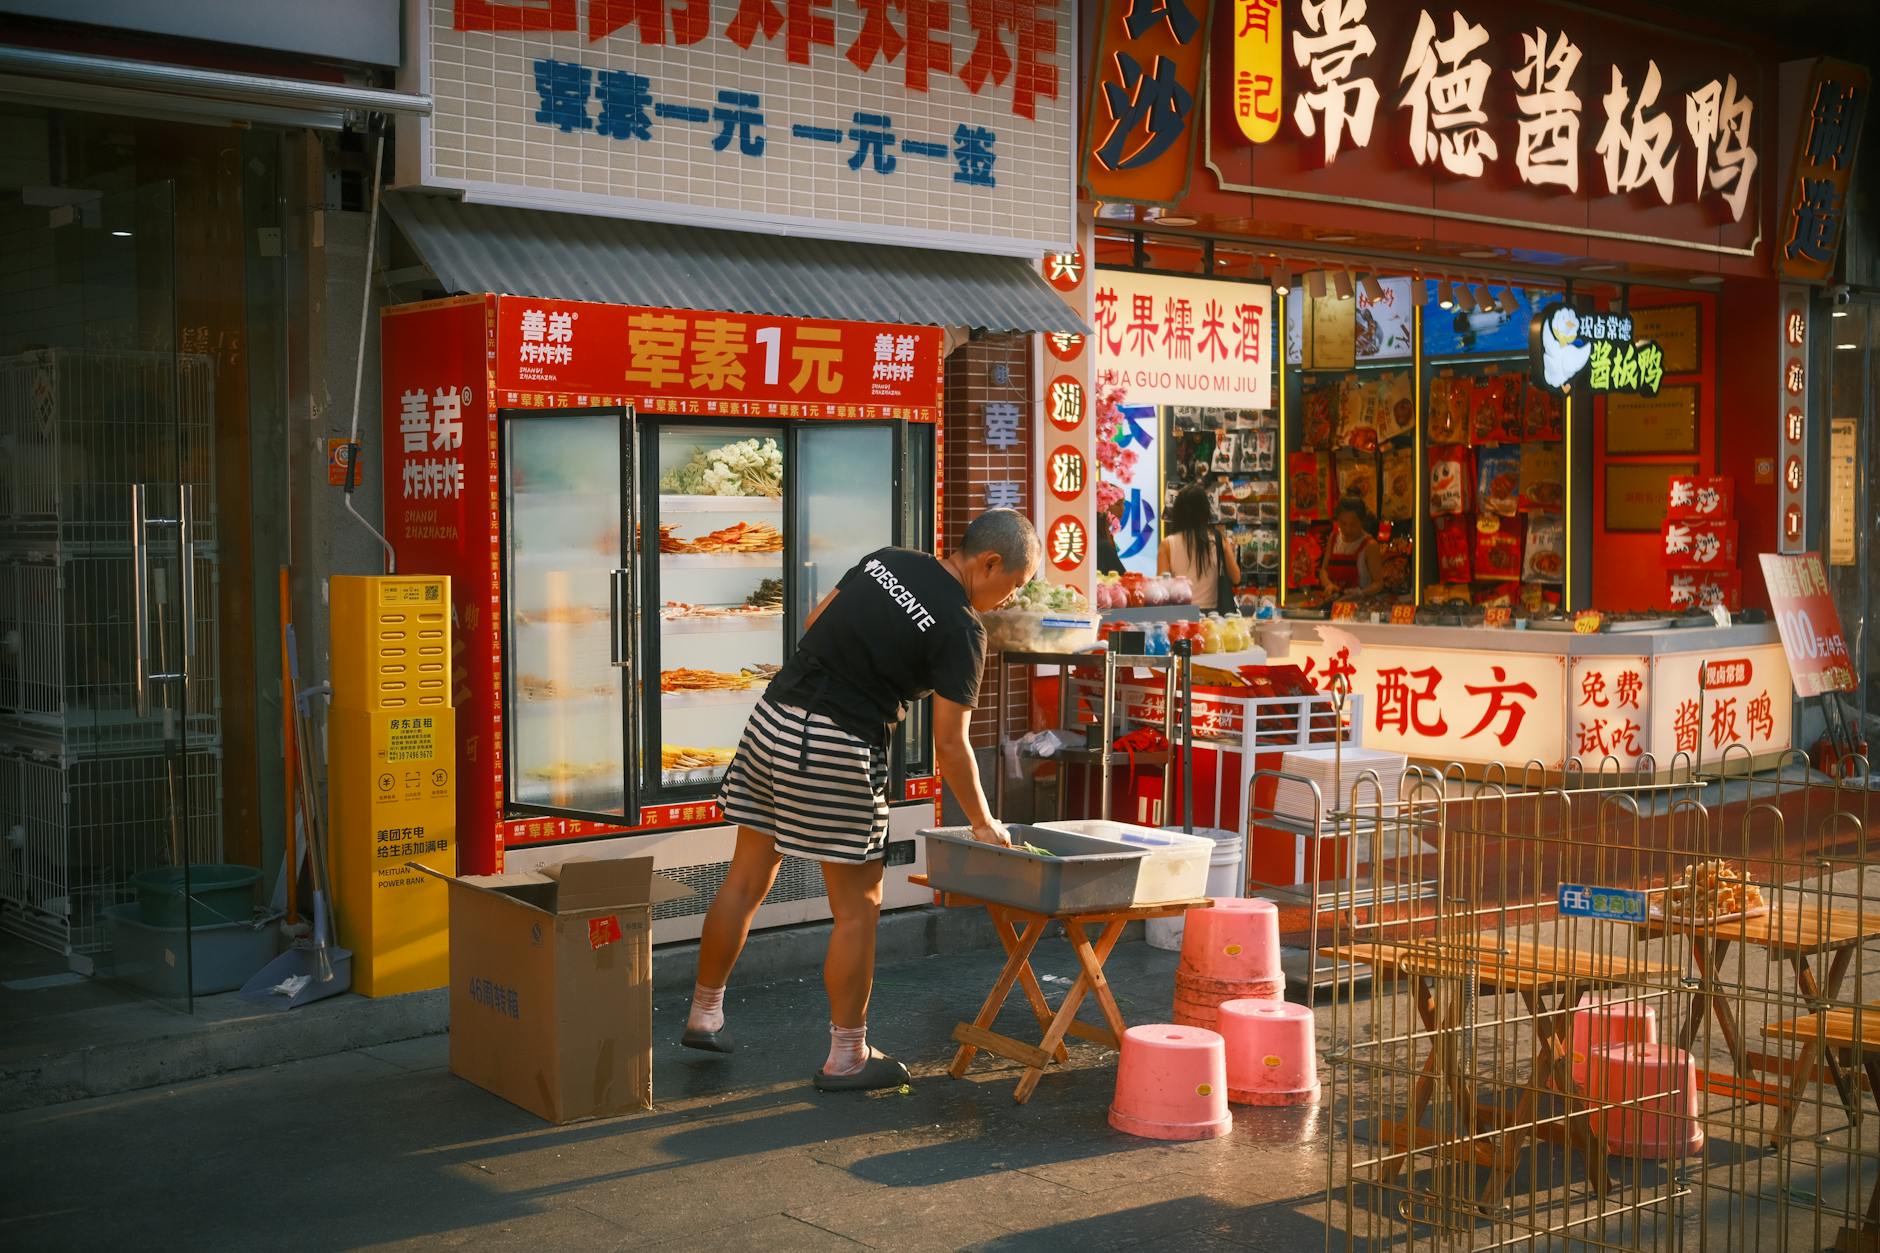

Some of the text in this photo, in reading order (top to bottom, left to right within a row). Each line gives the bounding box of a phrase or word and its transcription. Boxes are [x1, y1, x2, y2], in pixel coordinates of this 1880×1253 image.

[1095, 286, 1264, 364] 花果糯米酒
[520, 342, 572, 366] 炸炸炸
[625, 312, 844, 395] 荤素1元
[872, 362, 914, 382] 炸炸炸
[1590, 340, 1663, 393] 酱板鸭
[1135, 370, 1171, 388] GUO
[1176, 373, 1210, 391] NUO
[1213, 376, 1230, 392] MI
[1234, 376, 1257, 393] JIU
[402, 457, 465, 500] 炸炸炸
[869, 564, 937, 633] DESCENTE
[1393, 606, 1411, 617] 68
[1486, 608, 1506, 619] 58
[1578, 670, 1643, 710] 免费
[390, 718, 433, 730] 房东直租
[1673, 689, 1774, 754] 酱板鸭
[1576, 718, 1643, 757] 试吃
[377, 826, 425, 843] 美团充电
[377, 840, 448, 858] 给生活加满电
[378, 867, 411, 877] MEITUAN
[378, 877, 425, 888] POWER BANK
